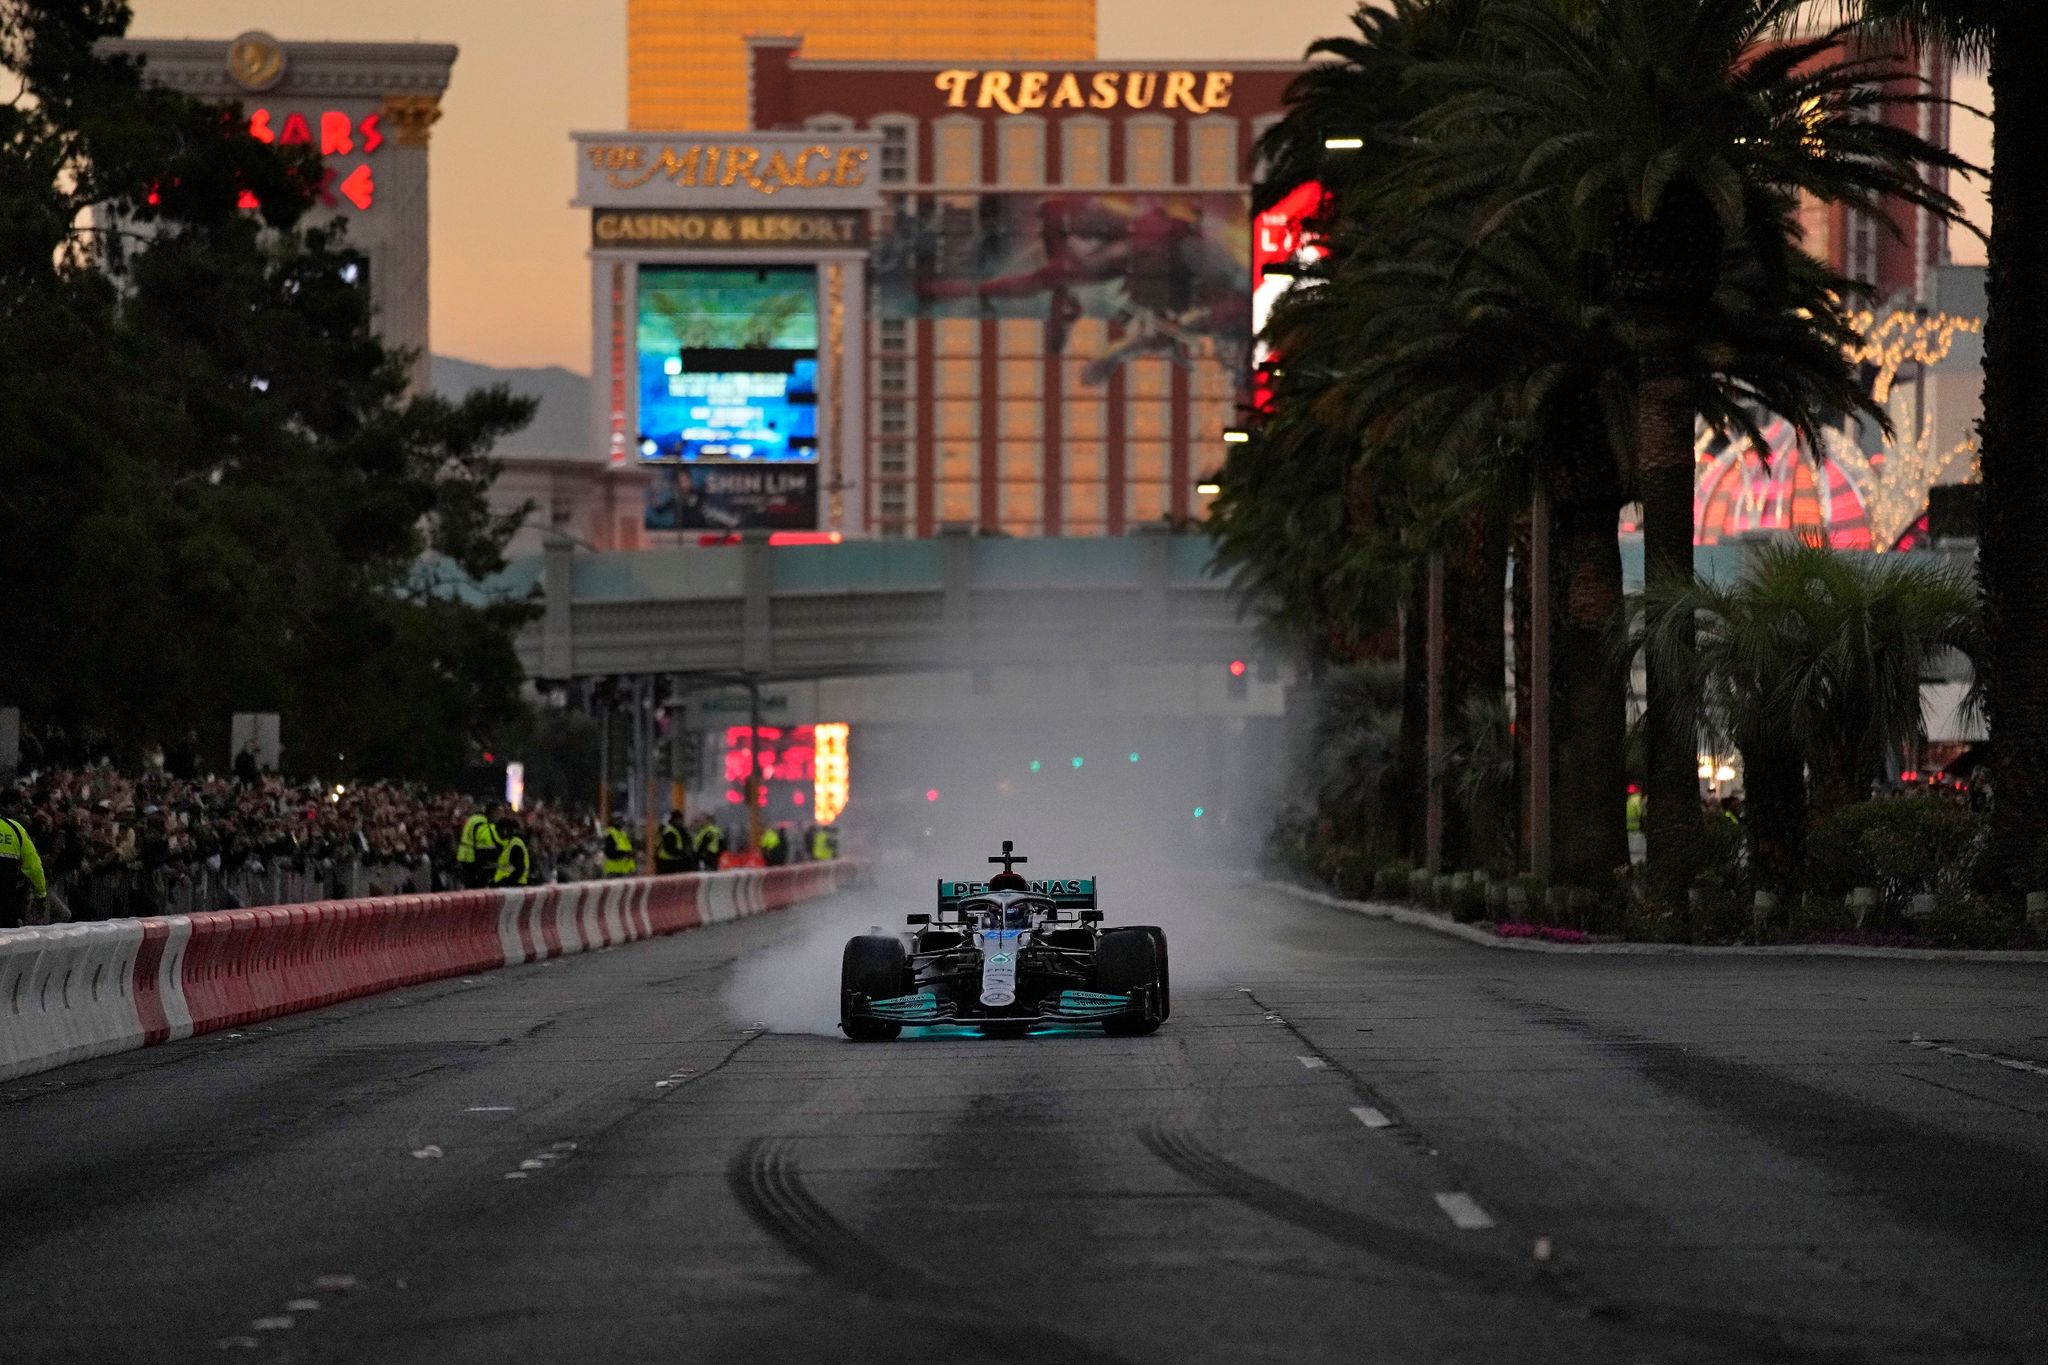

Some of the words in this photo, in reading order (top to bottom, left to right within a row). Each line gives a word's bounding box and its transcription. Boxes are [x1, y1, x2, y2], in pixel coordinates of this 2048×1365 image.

[935, 70, 1234, 114] TREASURE
[584, 144, 643, 170] THE
[607, 144, 868, 194] MIRAGE
[595, 214, 706, 241] CASINO
[711, 216, 732, 241] &
[739, 215, 856, 241] RESORT
